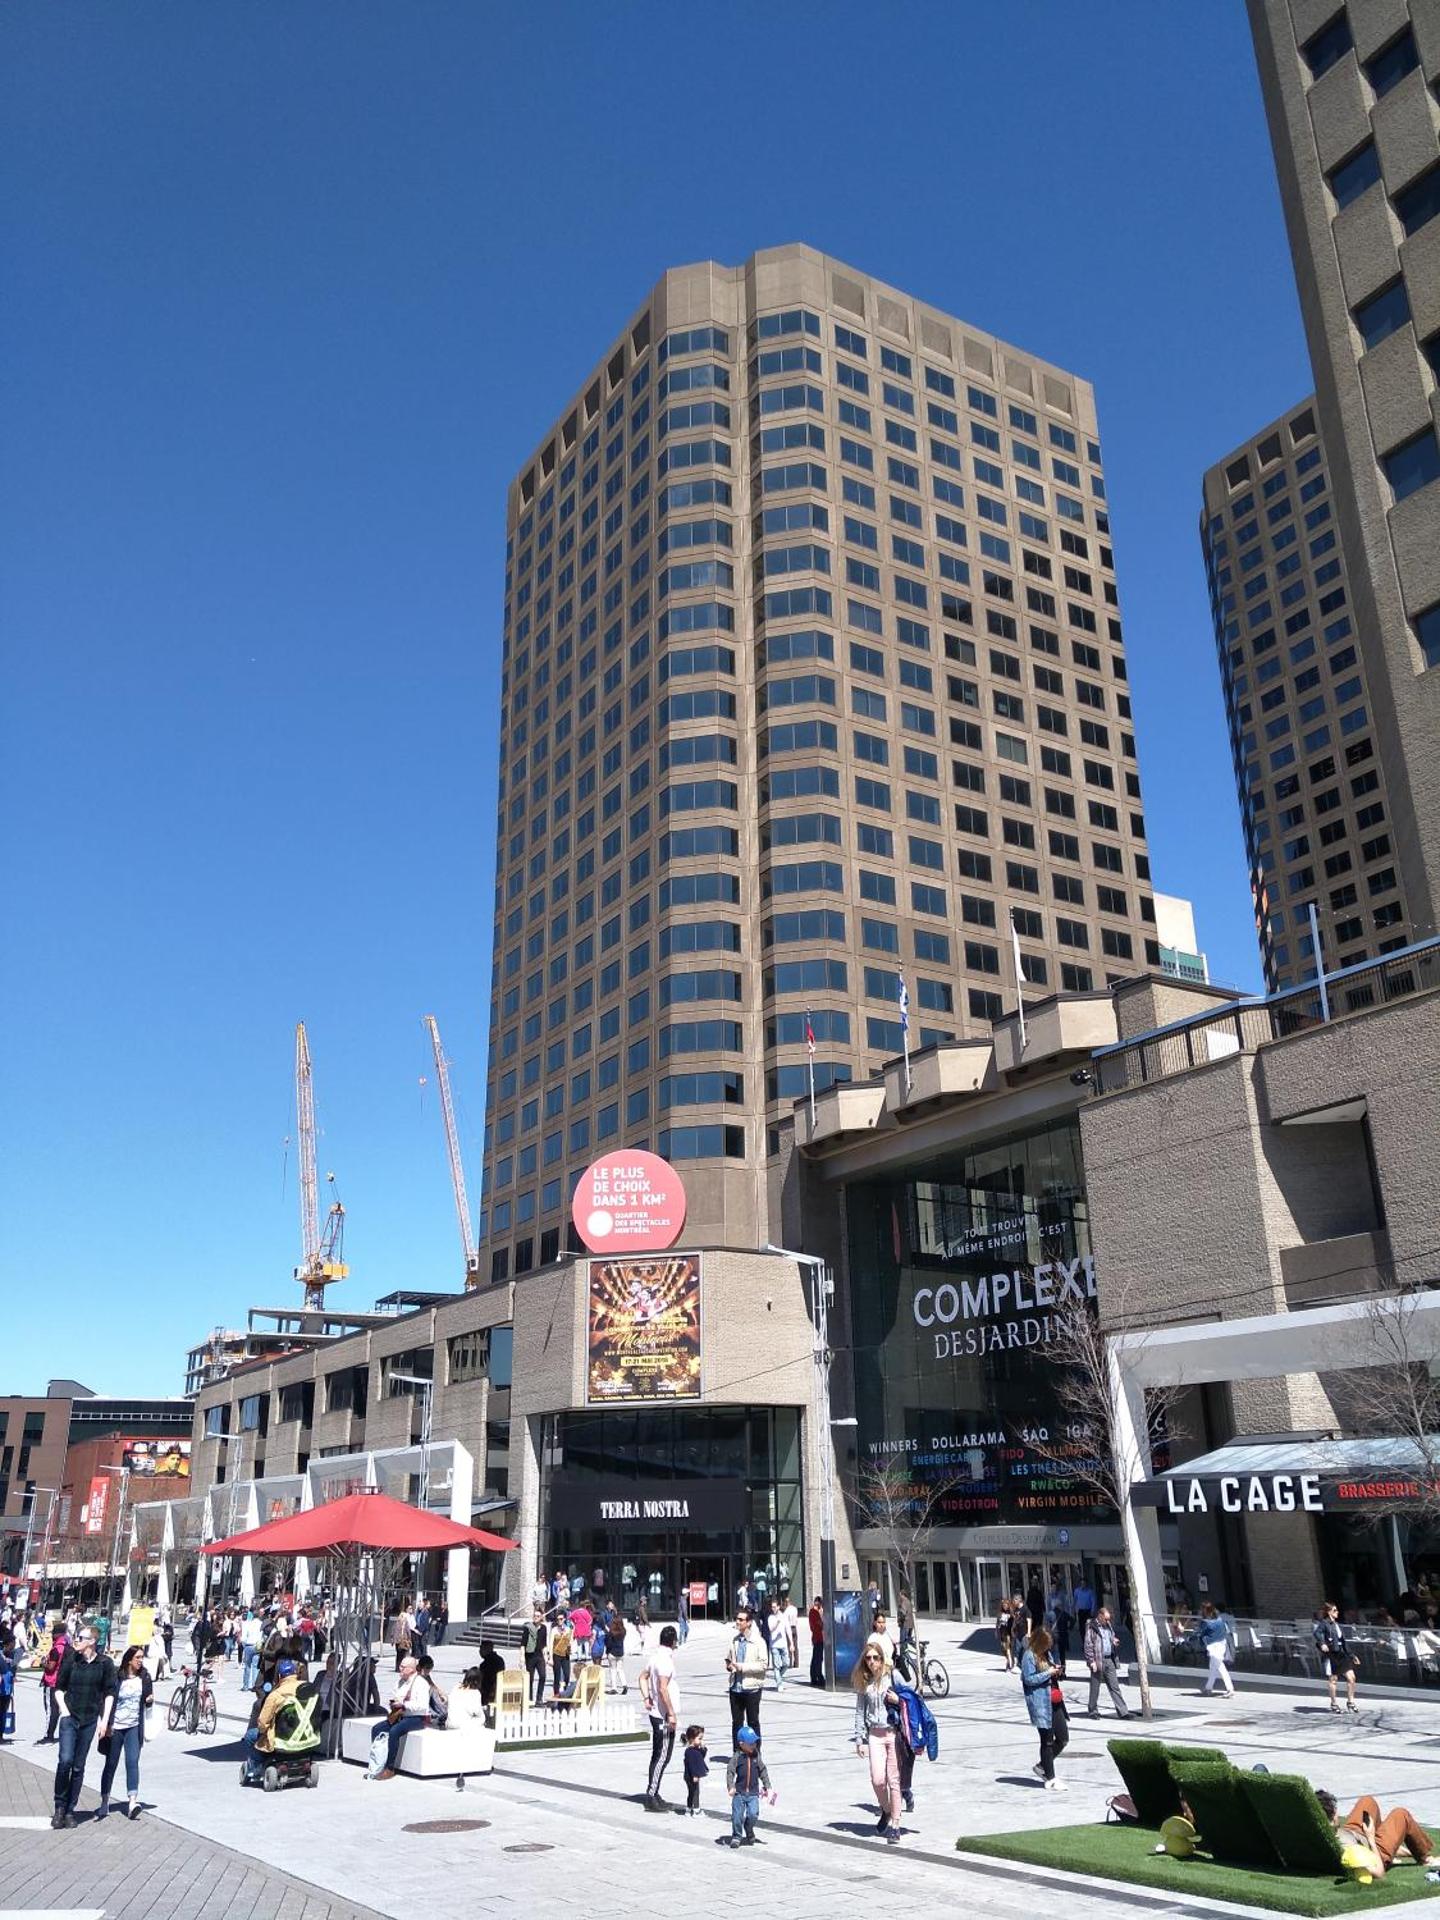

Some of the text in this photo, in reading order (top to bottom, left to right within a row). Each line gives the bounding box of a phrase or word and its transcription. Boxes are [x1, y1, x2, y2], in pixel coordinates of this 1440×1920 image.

[593, 1167, 645, 1180] LE PLUS
[593, 1180, 651, 1193] DE CHOIX
[593, 1194, 626, 1207] DANS
[630, 1195, 638, 1206] 1
[964, 1225, 988, 1239] TOU
[941, 1222, 1067, 1260] AU MÊME ENDROI C'EST
[913, 1254, 1097, 1327] COMPLEXE
[934, 1310, 1089, 1359] DESJARDINS
[869, 1439, 918, 1454] WINNERS
[932, 1431, 1006, 1450] DOLLARAMA
[1022, 1427, 1049, 1442] SAQ
[1011, 1464, 1029, 1475] LES
[1018, 1497, 1057, 1508] VIRGIN
[1060, 1494, 1107, 1506] MOBILE
[1167, 1478, 1208, 1513] LA
[1220, 1474, 1324, 1512] CAGE
[1338, 1482, 1420, 1499] BRASSERIE
[600, 1500, 689, 1519] TERRA NOSTRA
